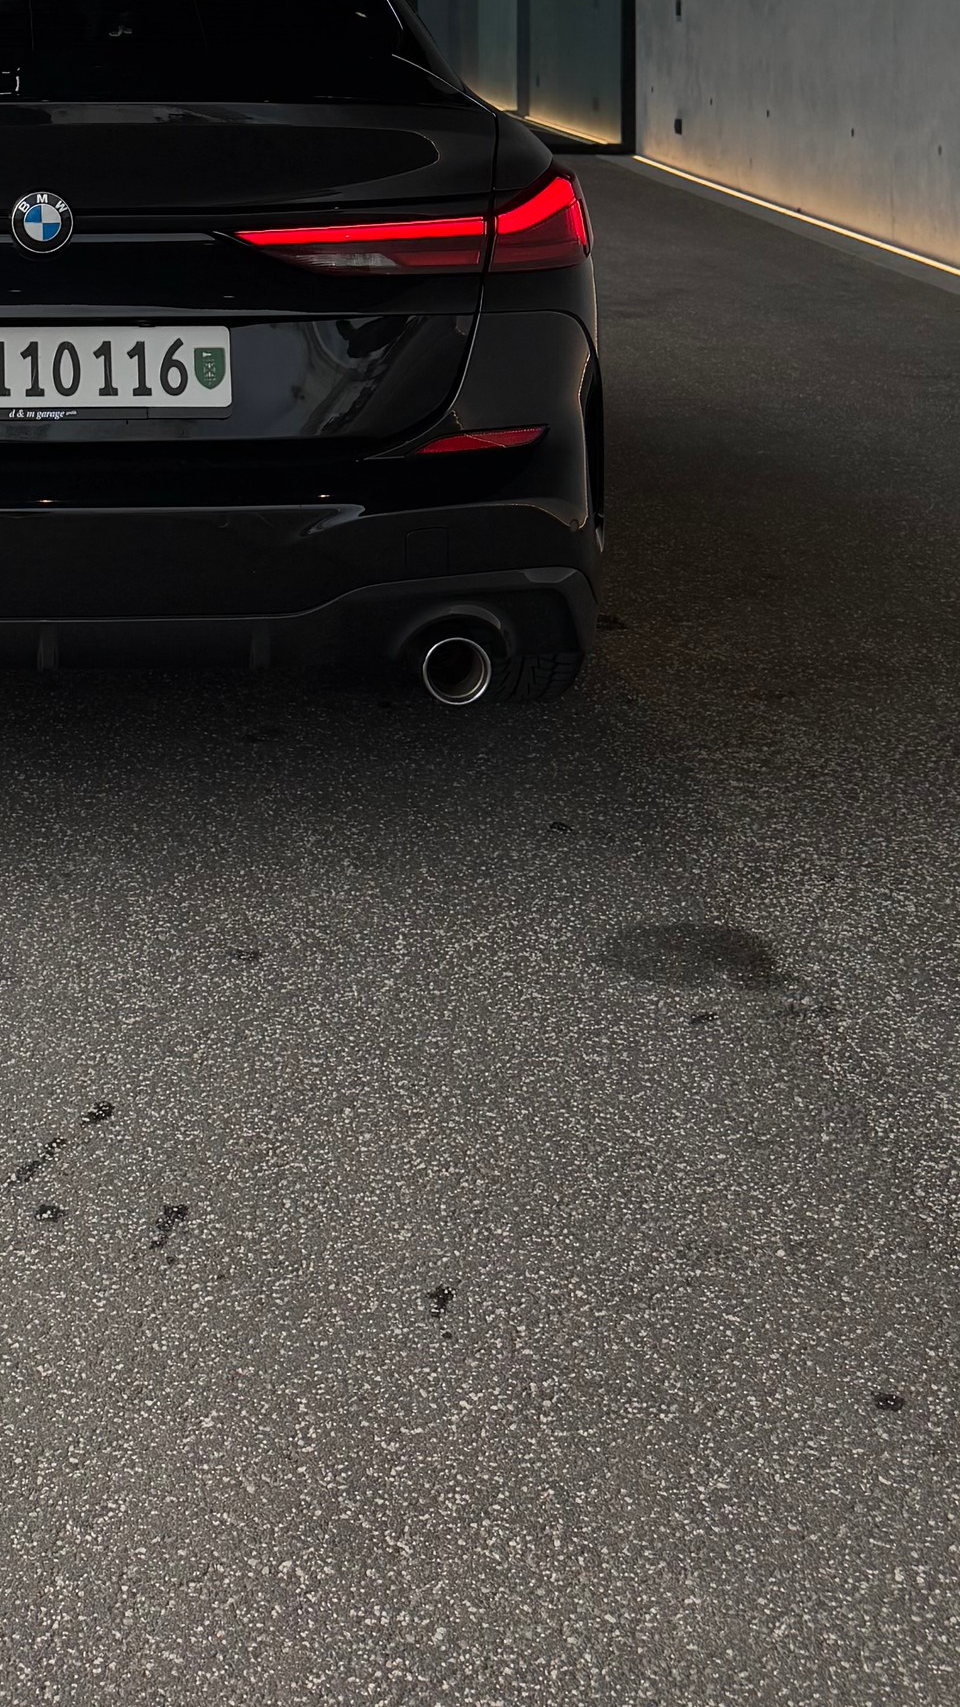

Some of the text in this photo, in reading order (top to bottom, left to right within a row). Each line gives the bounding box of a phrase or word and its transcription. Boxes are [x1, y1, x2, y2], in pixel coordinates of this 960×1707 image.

[18, 194, 68, 213] BMW
[9, 409, 16, 418] d
[16, 409, 25, 418] &
[36, 411, 65, 420] garage
